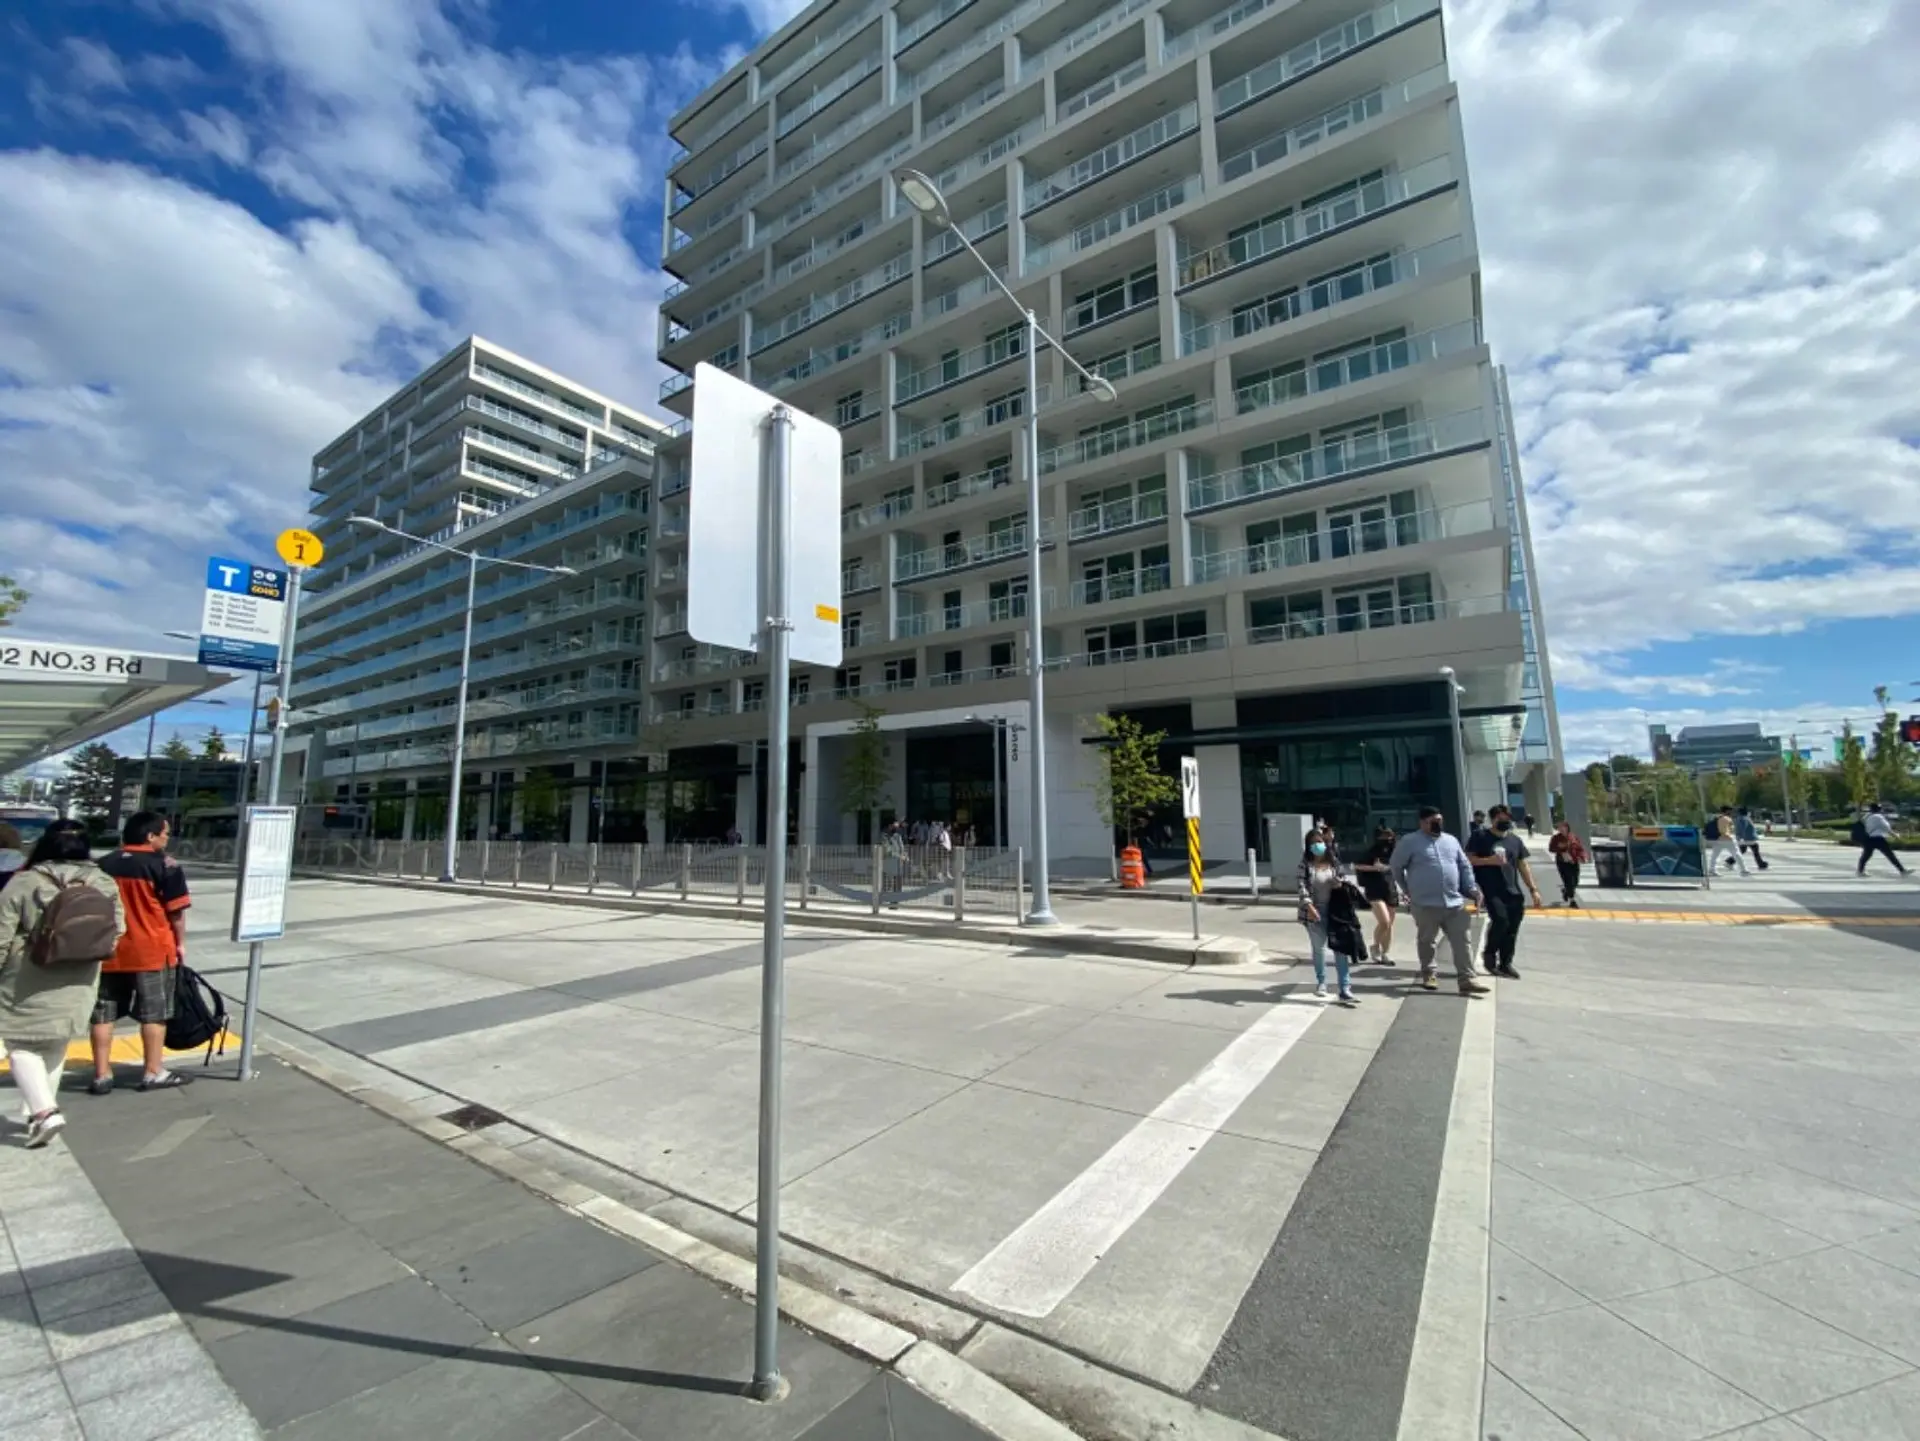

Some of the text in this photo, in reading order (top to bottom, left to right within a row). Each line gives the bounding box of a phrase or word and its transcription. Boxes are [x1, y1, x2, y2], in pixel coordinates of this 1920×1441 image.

[295, 543, 304, 560] 1
[218, 565, 241, 588] T
[0, 647, 141, 674] 2 NO.3 Rd
